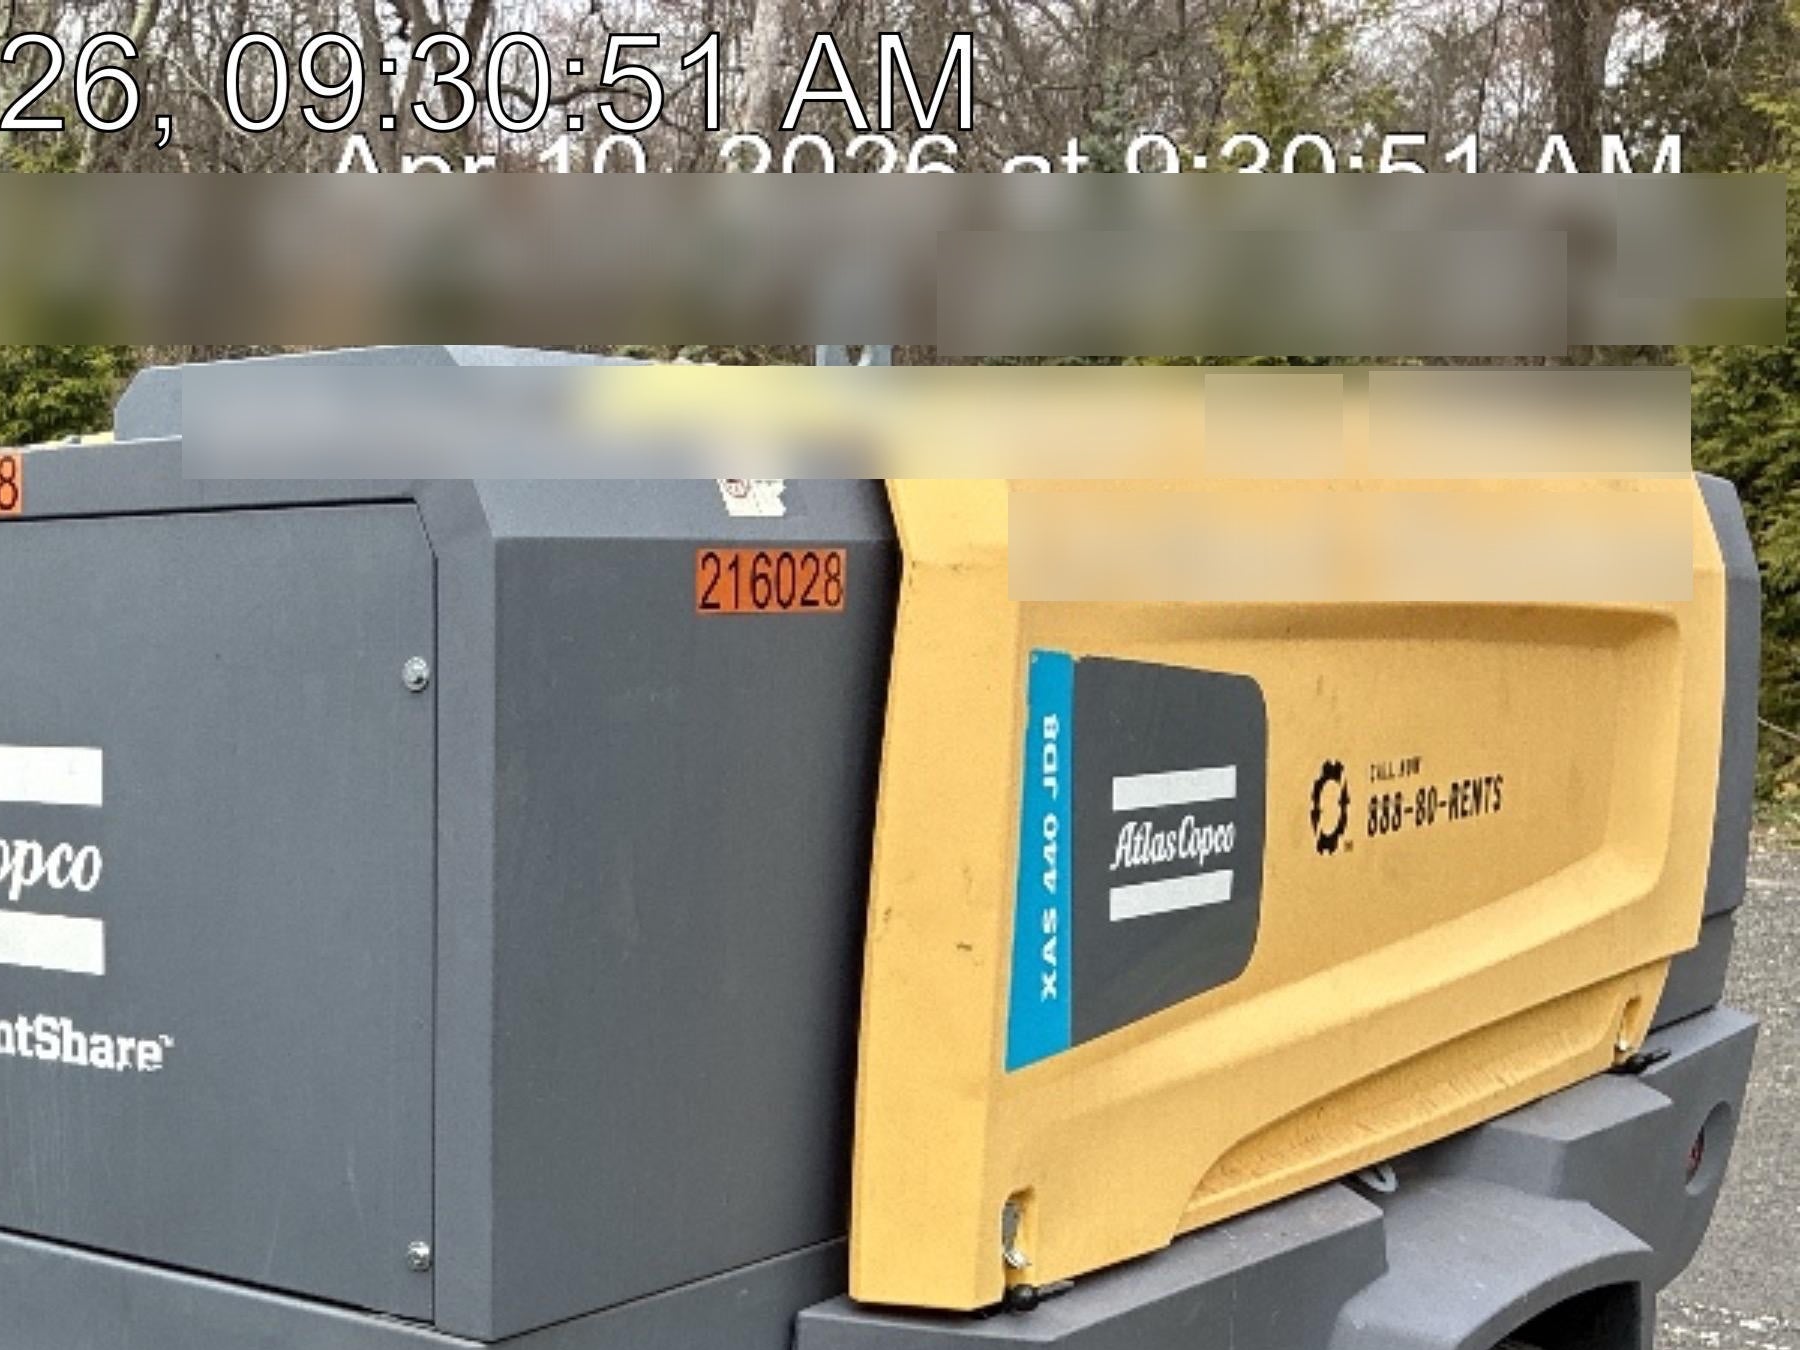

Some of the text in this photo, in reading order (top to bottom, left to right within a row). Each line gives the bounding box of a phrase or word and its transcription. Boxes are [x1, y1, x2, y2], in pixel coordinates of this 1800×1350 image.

[699, 551, 842, 610] 216028
[1367, 773, 1504, 838] 888-80-RENTS
[1042, 813, 1059, 894] 440
[1109, 815, 1236, 870] Atlas Copco
[1040, 908, 1057, 1002] XAS
